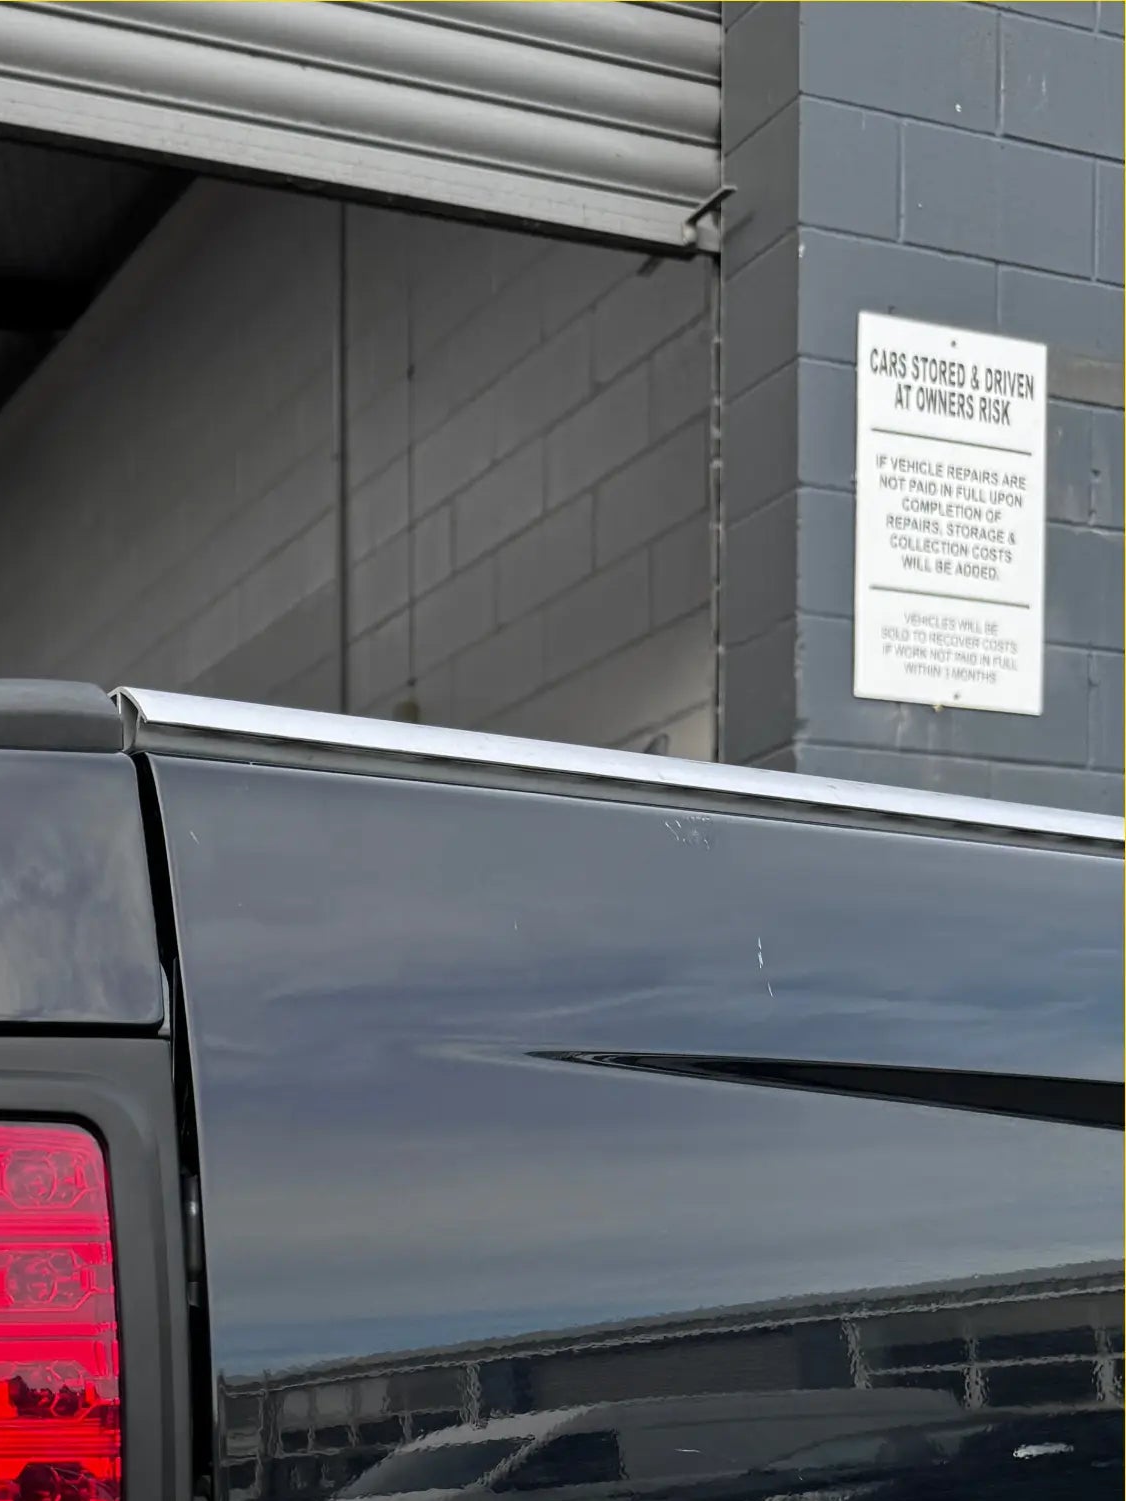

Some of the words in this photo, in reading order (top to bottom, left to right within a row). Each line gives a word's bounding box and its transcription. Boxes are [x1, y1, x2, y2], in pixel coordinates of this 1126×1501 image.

[870, 348, 907, 379] CARS
[912, 355, 966, 389] STORED
[971, 365, 980, 391] &
[985, 368, 1034, 401] DRIVEN
[895, 384, 912, 411] AT
[916, 387, 975, 421] OWNERS
[979, 397, 1011, 426] RISK
[876, 454, 888, 468] IF
[891, 457, 943, 478] VEHICLE
[947, 464, 998, 485] REPAIRS
[1001, 473, 1027, 490] ARE
[879, 475, 906, 491] NOT
[909, 479, 937, 496] PAID
[940, 484, 952, 497] IN
[956, 486, 985, 503] FULL
[990, 490, 1023, 508] UPON
[902, 498, 981, 522] COMPLETION
[985, 509, 1002, 523] OF
[890, 533, 968, 557] COLLECTION
[972, 545, 1012, 563] COSTS
[946, 523, 1005, 544] STORAGE
[1008, 531, 1016, 545] &
[902, 555, 931, 573] WILL
[935, 560, 952, 574] BE
[904, 611, 955, 630] VEHICLES
[958, 619, 982, 634] WILL
[985, 621, 999, 636] BE
[881, 626, 910, 642] SOLD
[913, 630, 926, 643] TO
[929, 633, 979, 649] RECOVER
[982, 639, 1018, 655] COSTS
[894, 644, 927, 659] WORK
[929, 649, 951, 663] NOT
[954, 652, 977, 666] PAID
[992, 656, 1018, 672] FULL
[903, 662, 941, 678] WITHIN
[951, 668, 997, 684] MONTHS
